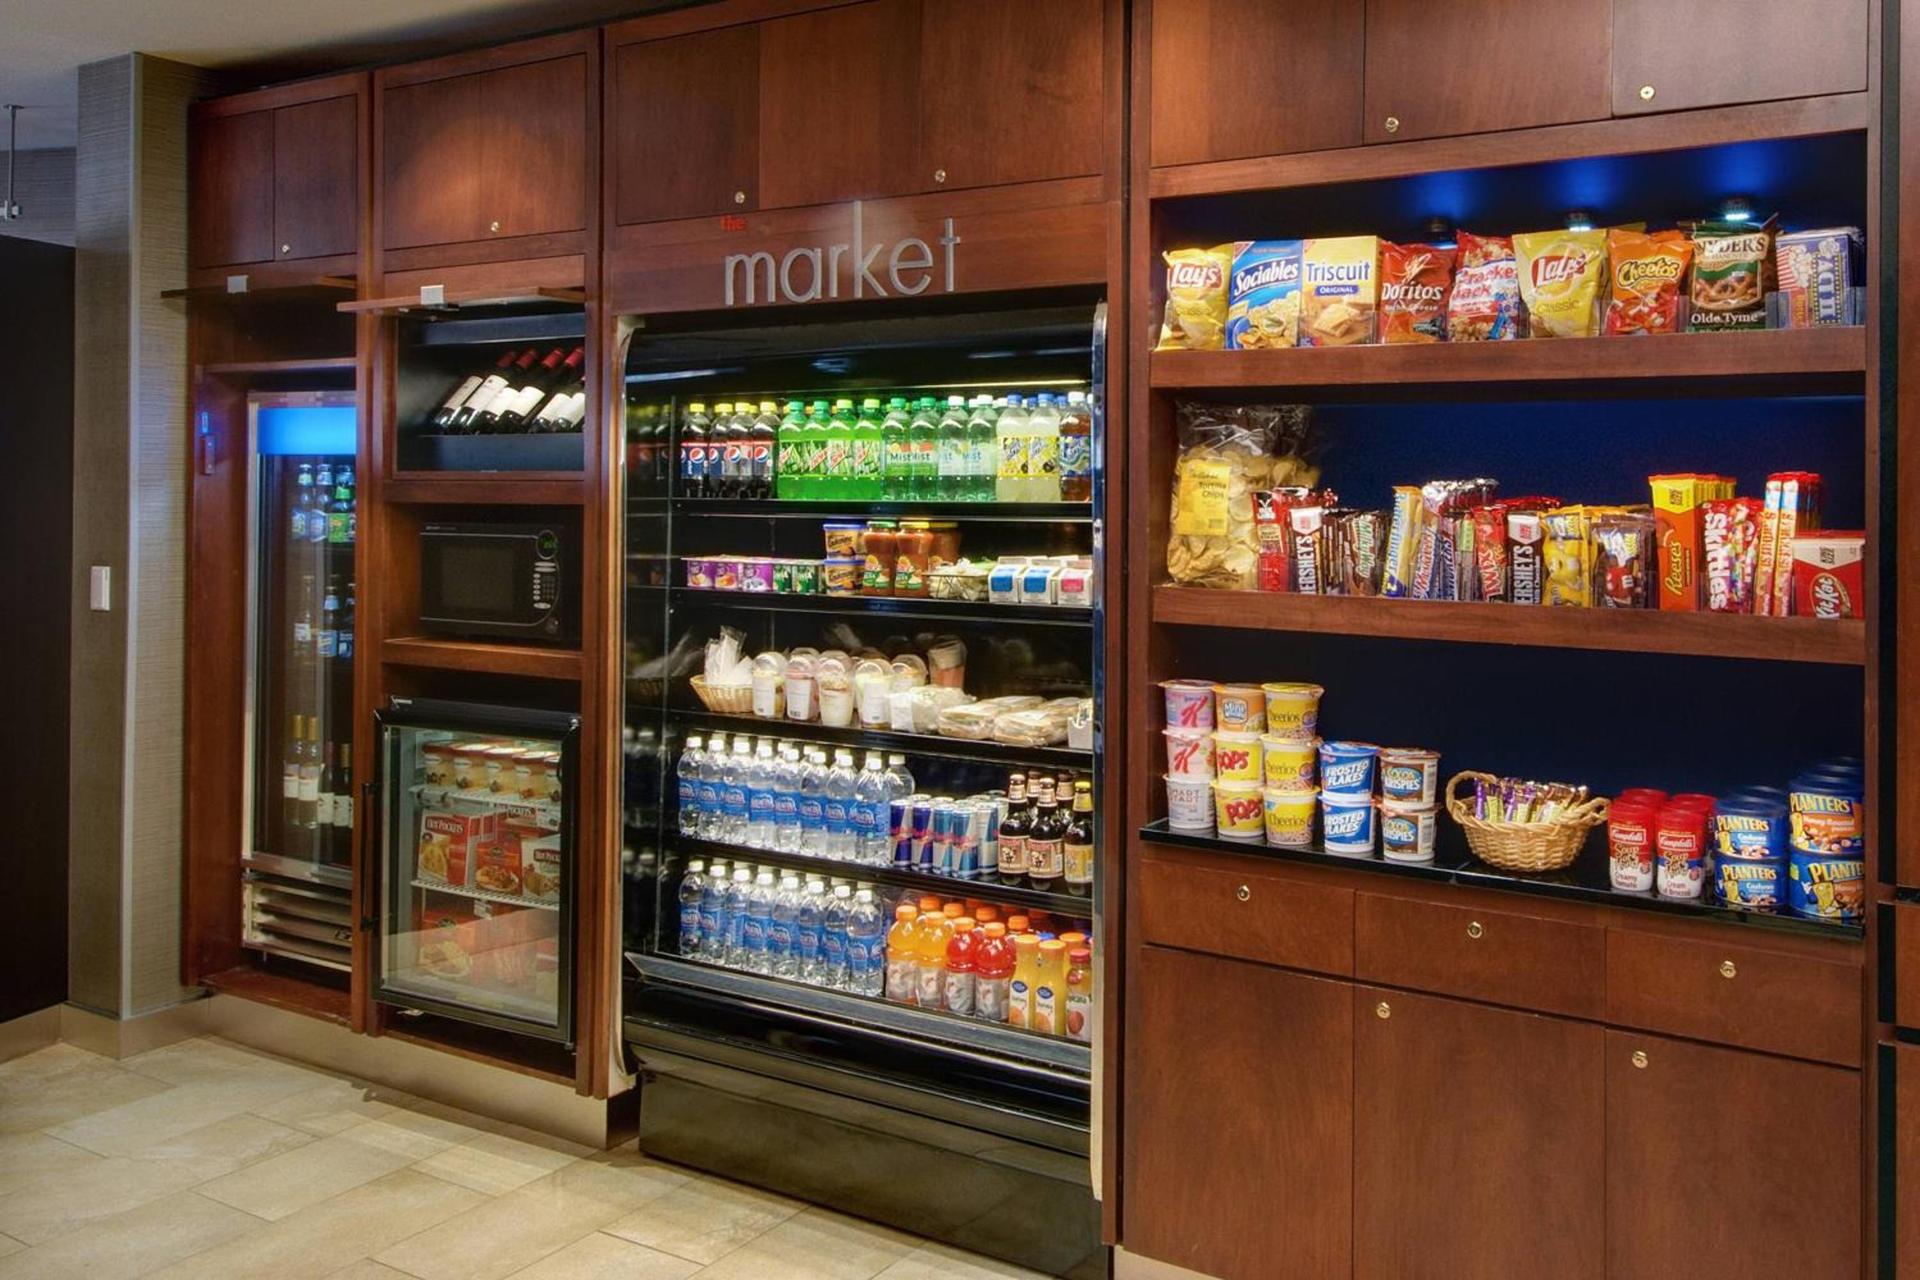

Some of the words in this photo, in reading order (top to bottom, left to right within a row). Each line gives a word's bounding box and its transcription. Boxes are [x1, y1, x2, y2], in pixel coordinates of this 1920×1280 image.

[720, 214, 746, 231] the
[725, 200, 961, 306] market
[1234, 260, 1298, 296] Sociables
[1306, 260, 1370, 281] Triscuit
[1619, 258, 1680, 287] Cheetos
[1319, 285, 1354, 295] ORIGINAL
[1382, 282, 1443, 300] Doritos
[1691, 312, 1724, 325] Olde
[1725, 311, 1759, 325] Tyme
[1297, 536, 1317, 594] ERSHEY'S
[1706, 512, 1731, 610] Skittles
[1478, 549, 1504, 601] TWIX
[1513, 545, 1534, 604] ERSHEY'S
[1327, 758, 1369, 776] FROSTED
[1327, 770, 1366, 786] FLAKES
[1790, 792, 1850, 812] PLANTERS
[1717, 815, 1770, 832] PLANTERS
[1722, 864, 1777, 881] PLANTERS
[1808, 862, 1864, 883] PLANTE
